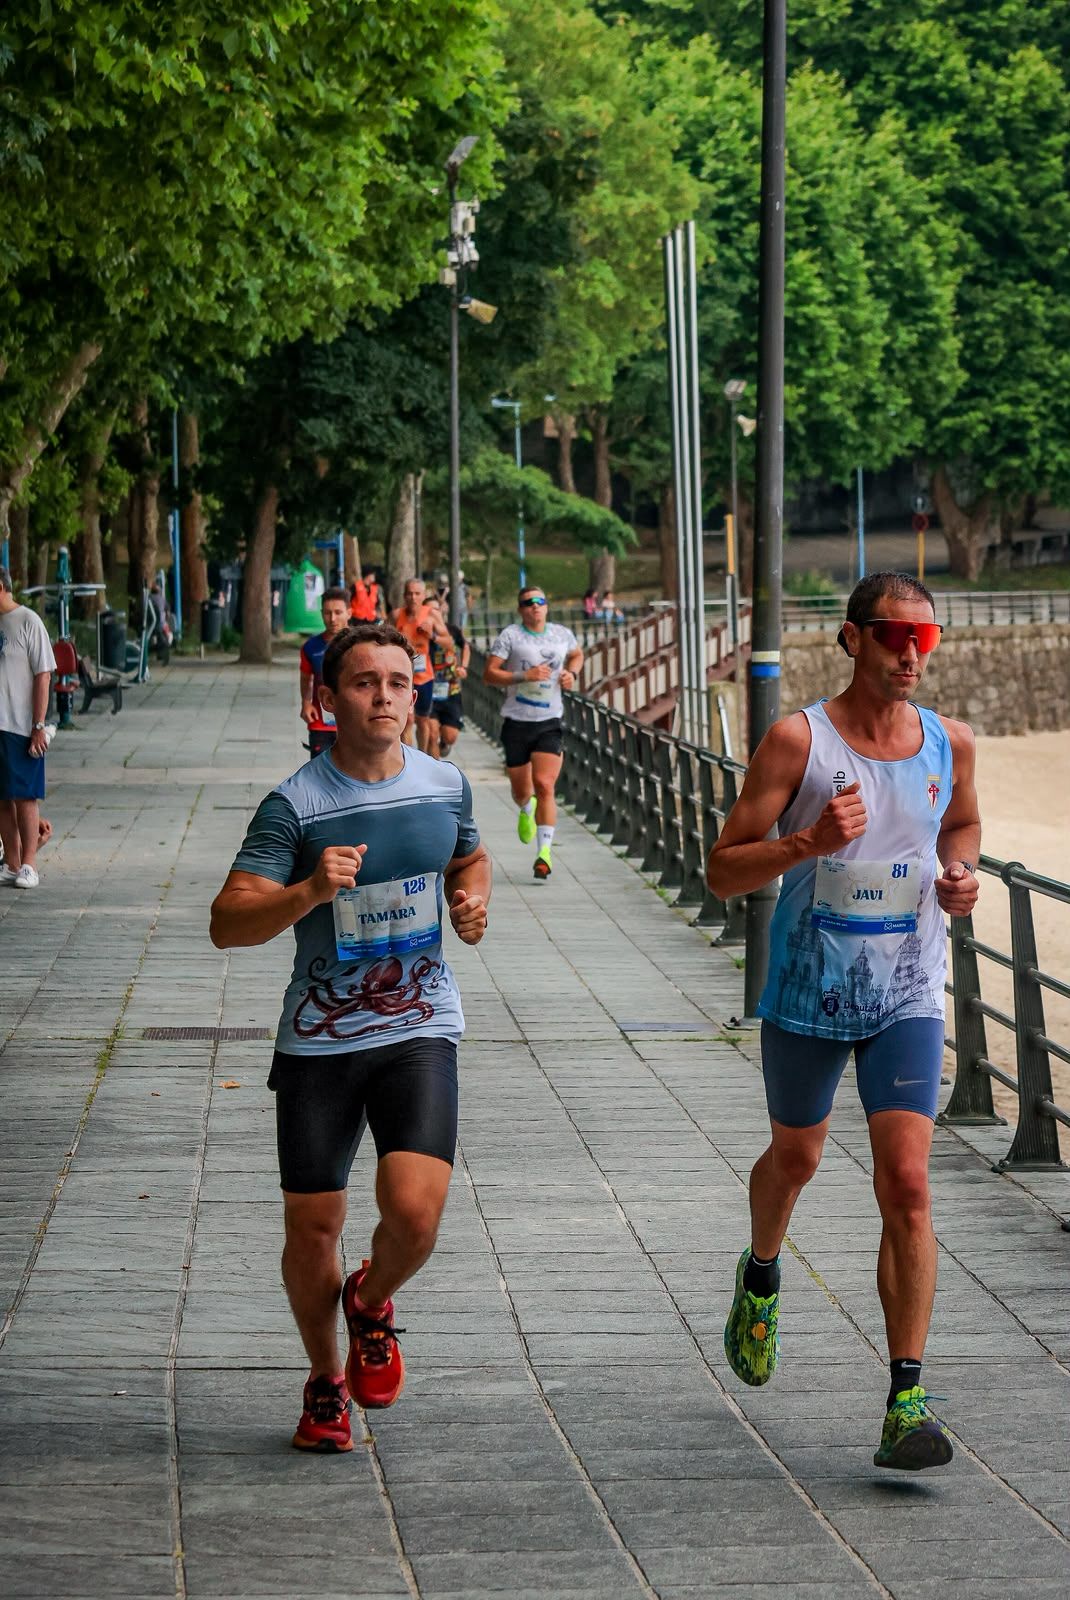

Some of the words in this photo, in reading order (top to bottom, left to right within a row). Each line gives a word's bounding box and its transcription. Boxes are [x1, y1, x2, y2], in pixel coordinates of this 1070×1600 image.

[892, 863, 908, 878] 81
[403, 877, 426, 896] 128
[852, 889, 883, 900] JAVI
[358, 906, 416, 924] TAMARA
